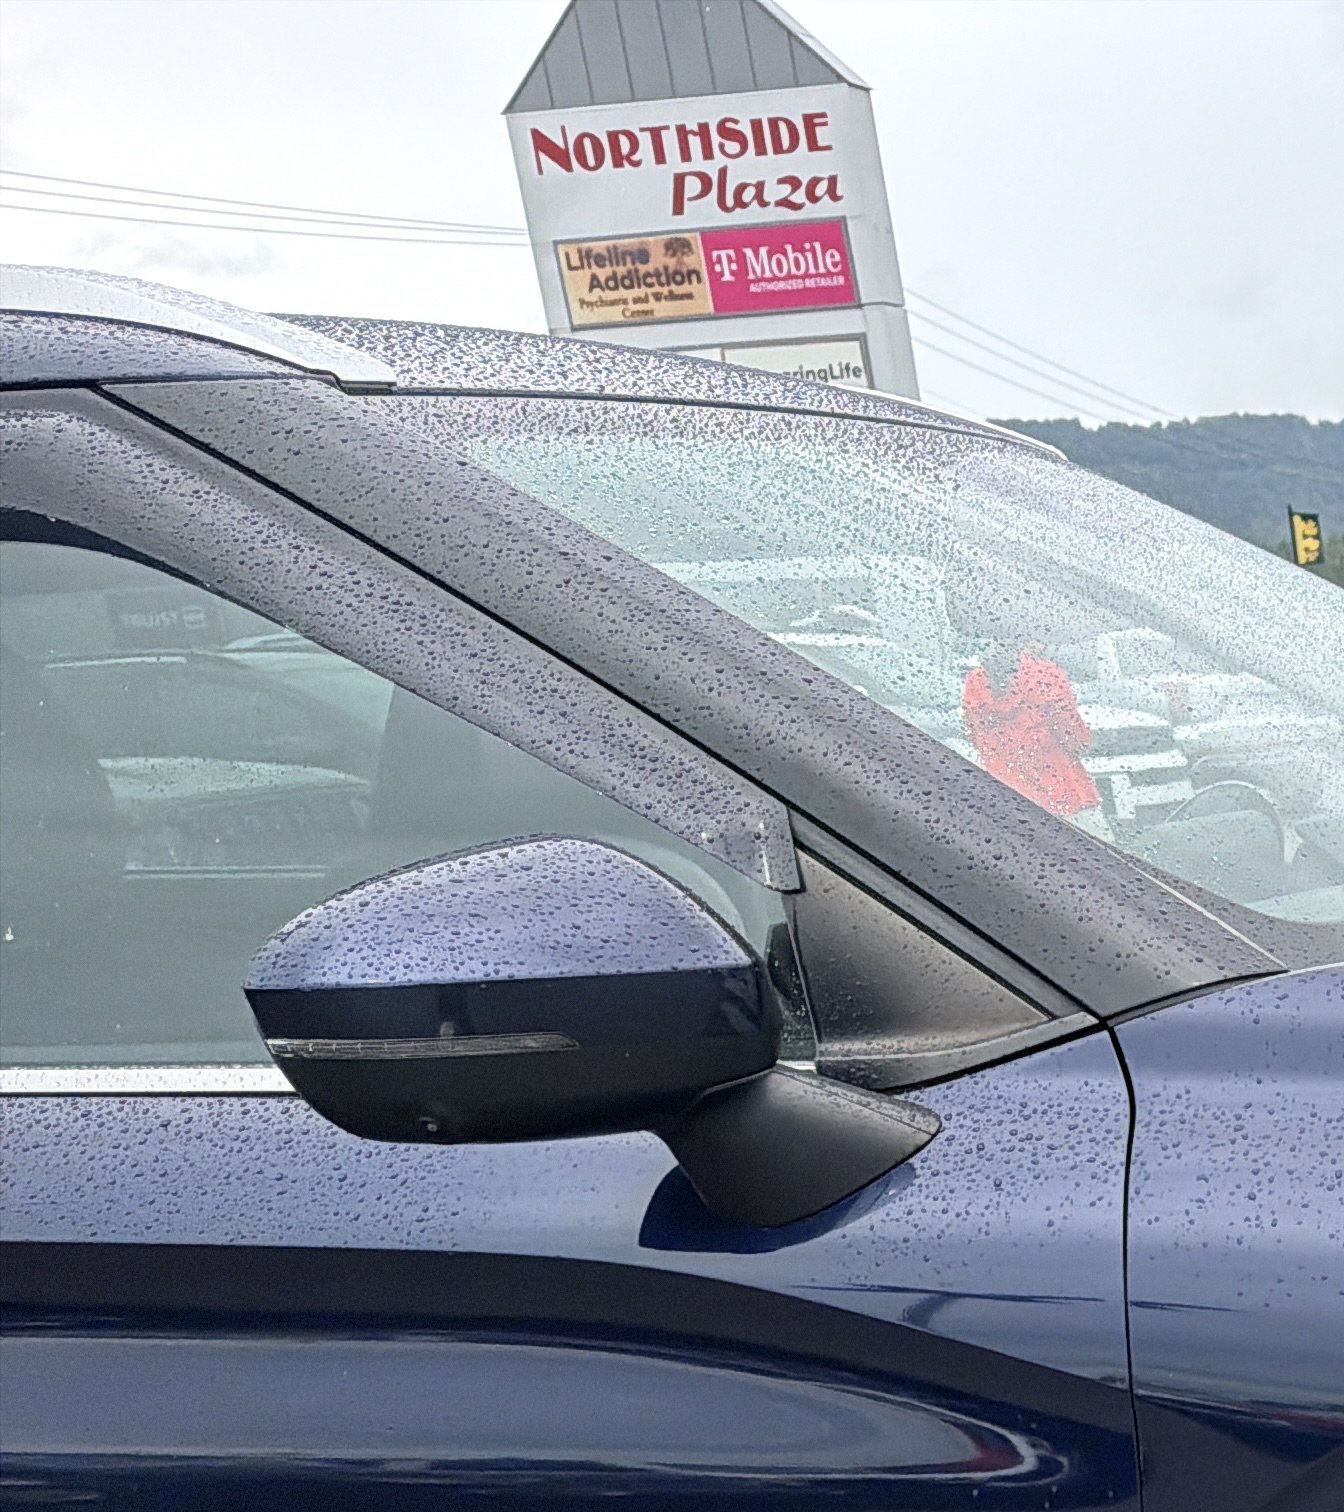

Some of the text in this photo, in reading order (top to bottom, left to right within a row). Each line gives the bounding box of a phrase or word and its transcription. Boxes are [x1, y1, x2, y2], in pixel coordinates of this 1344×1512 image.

[530, 112, 834, 175] NORTHSIDE
[671, 165, 844, 216] Plaza
[565, 244, 650, 271] Lifeline
[742, 241, 842, 279] Mobile
[588, 265, 702, 293] Addiction
